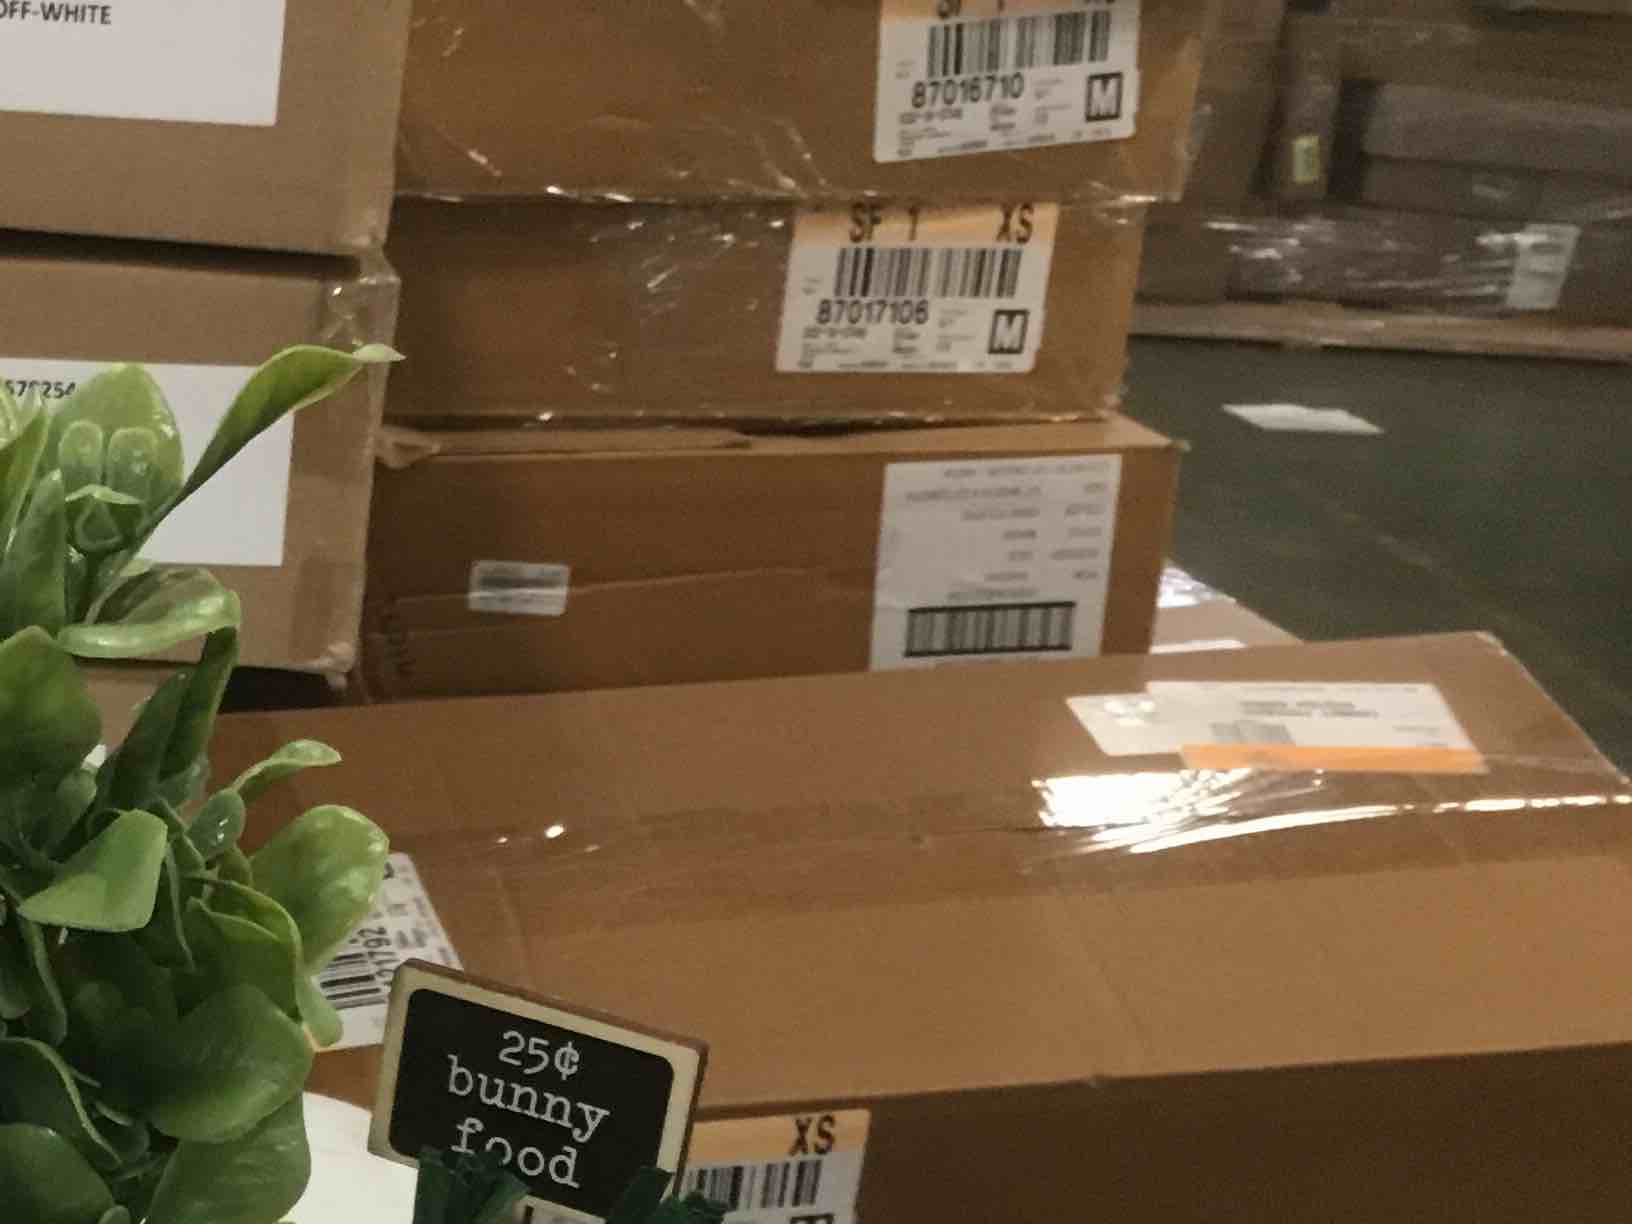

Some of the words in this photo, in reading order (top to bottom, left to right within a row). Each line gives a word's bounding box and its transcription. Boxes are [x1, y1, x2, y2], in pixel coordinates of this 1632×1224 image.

[995, 202, 1035, 244] XS
[498, 1030, 581, 1081] 25¢
[447, 1053, 611, 1143] bunny
[450, 1116, 581, 1189] food
[787, 1114, 836, 1156] XS
